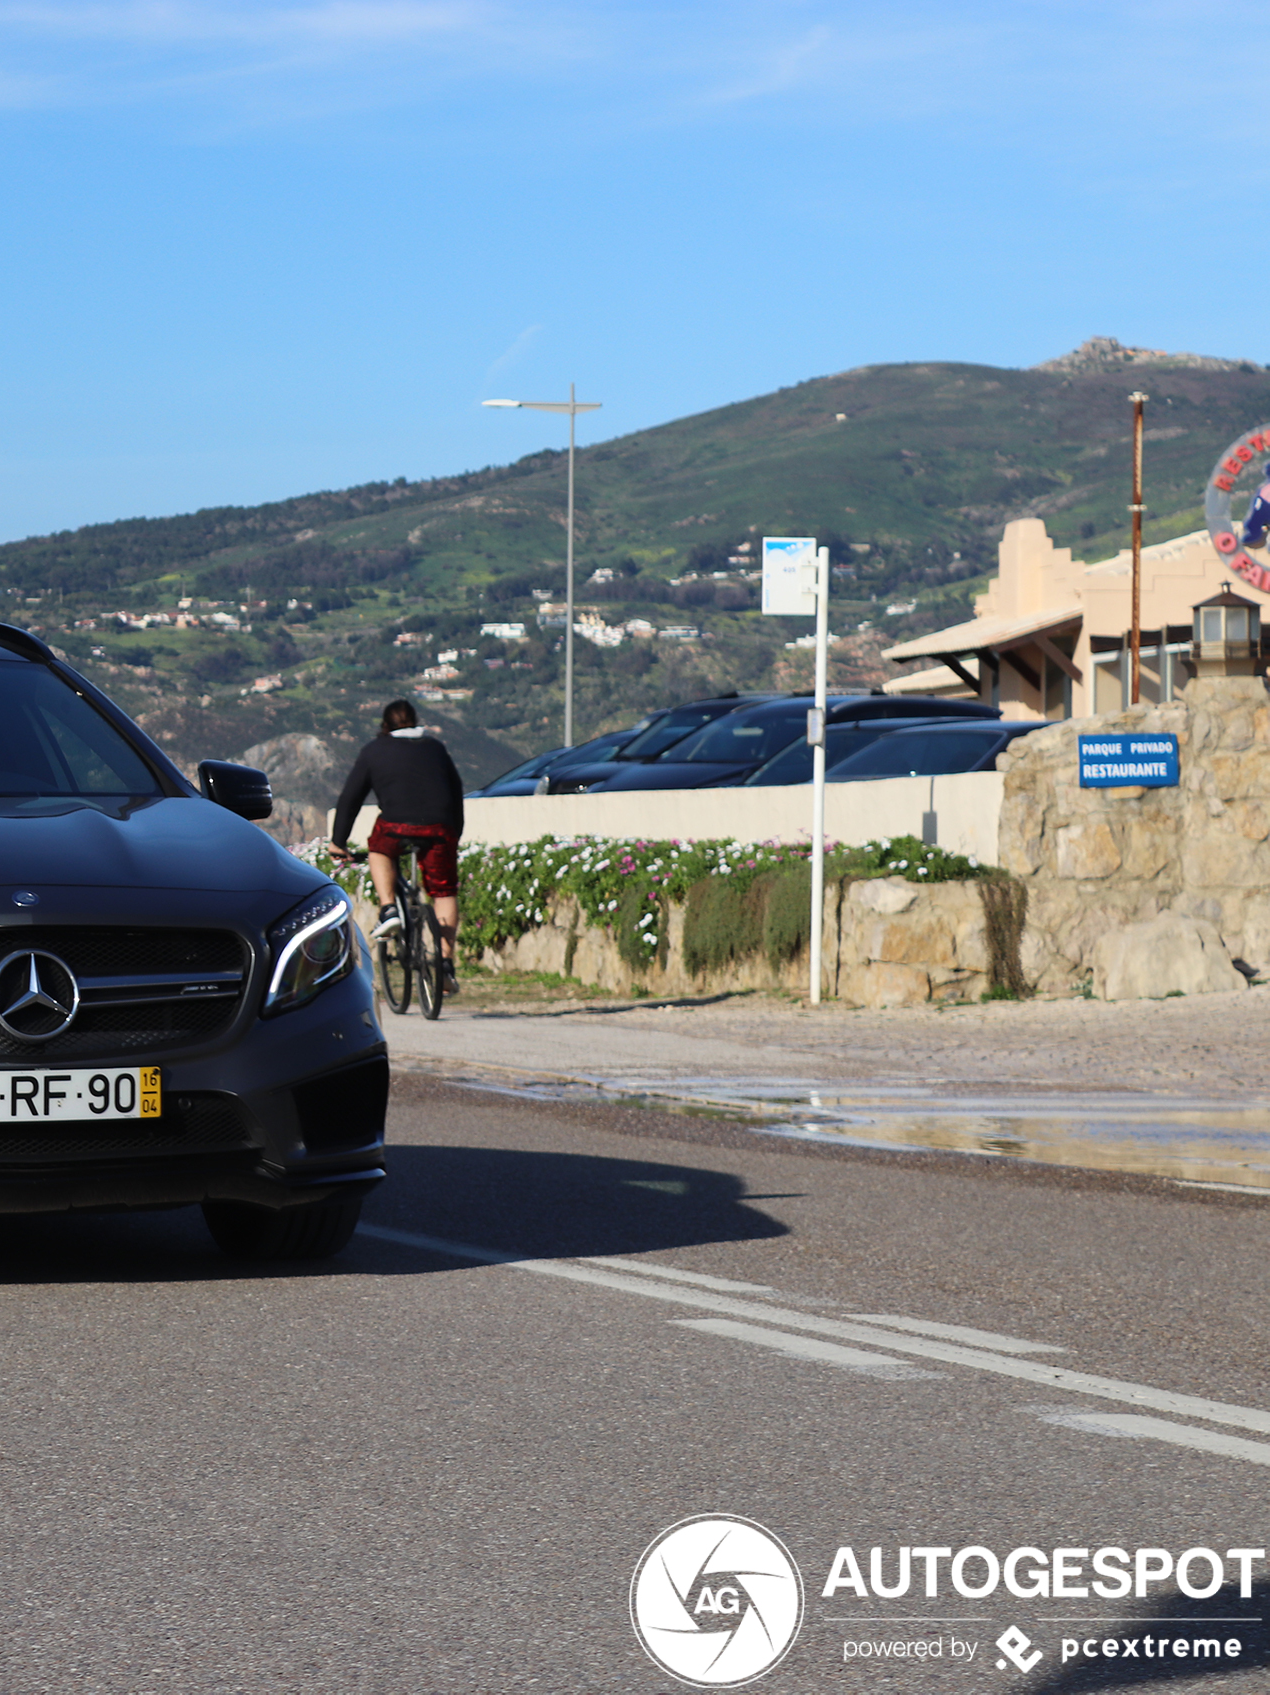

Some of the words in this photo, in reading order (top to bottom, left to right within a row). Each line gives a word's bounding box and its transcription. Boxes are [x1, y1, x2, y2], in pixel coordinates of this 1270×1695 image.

[1082, 742, 1122, 757] PARQUE
[1130, 742, 1173, 754] PRIVADO
[1083, 762, 1168, 778] RESTAURANTE
[143, 1072, 158, 1087] 16
[142, 1098, 158, 1113] 04
